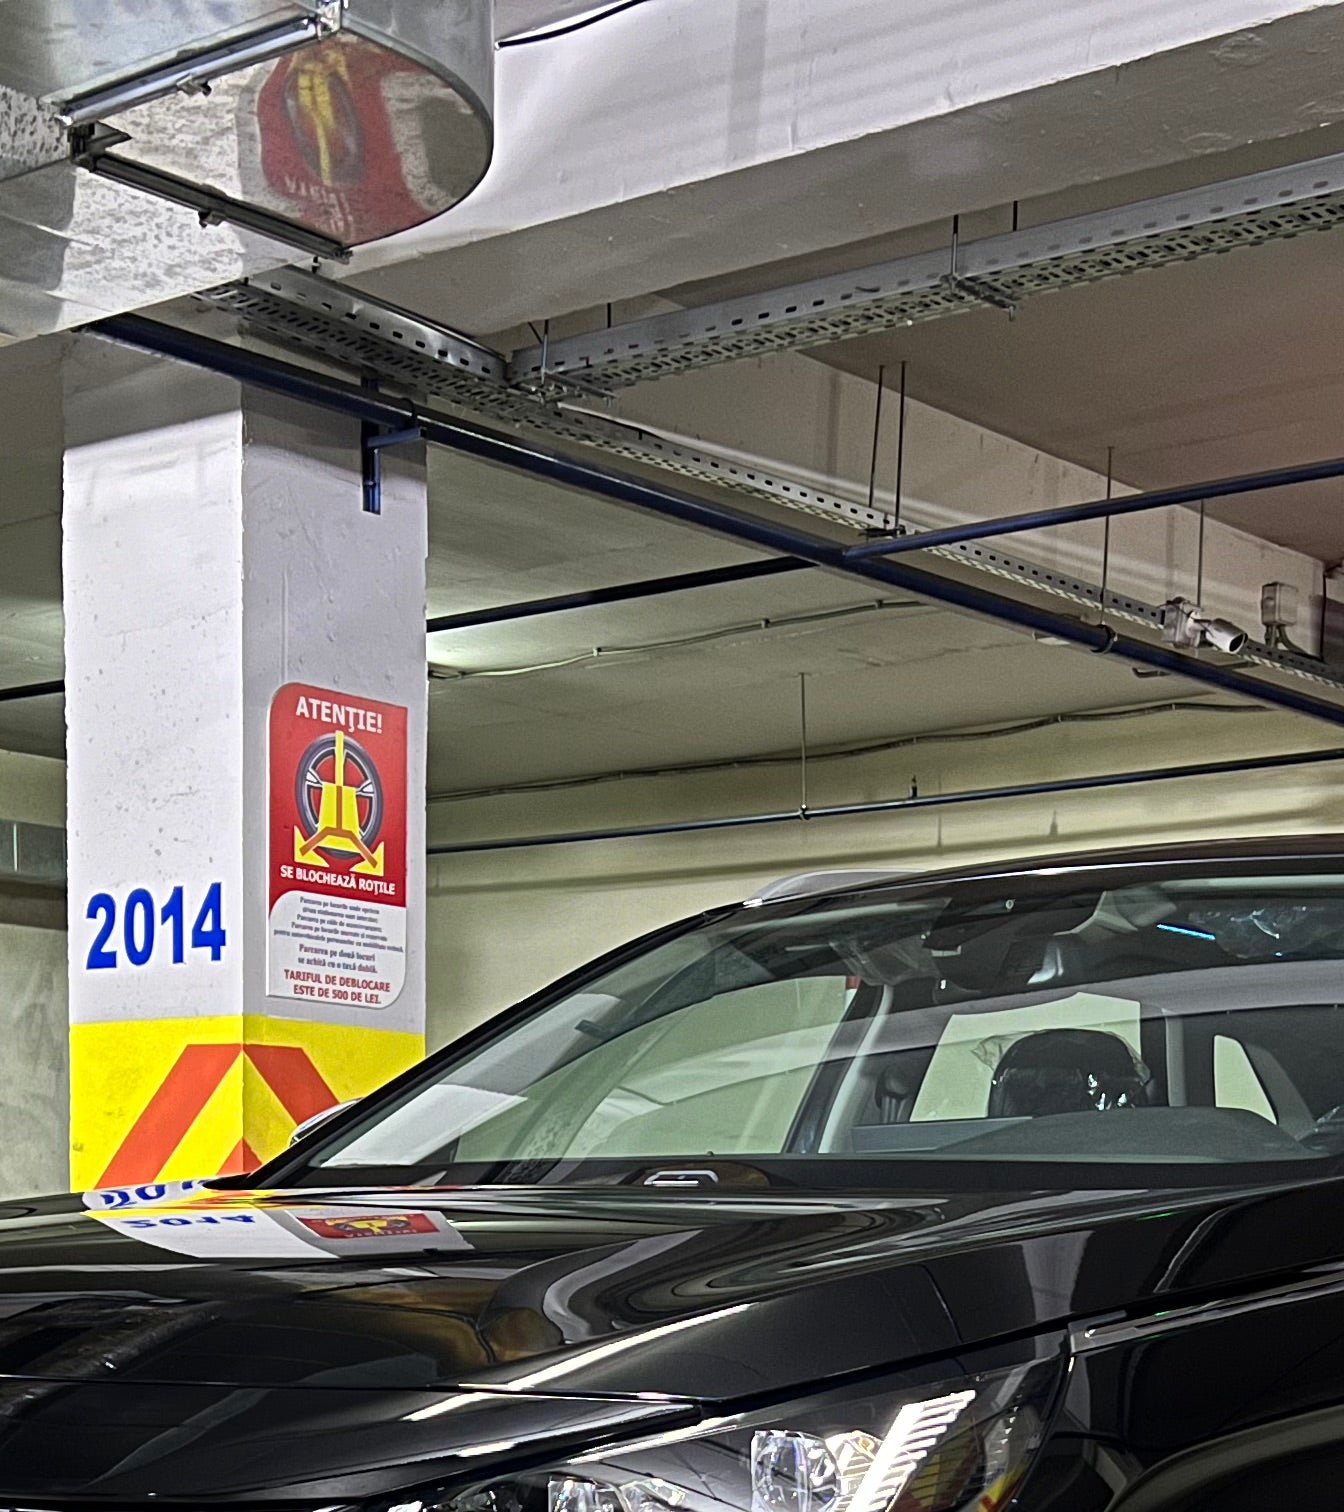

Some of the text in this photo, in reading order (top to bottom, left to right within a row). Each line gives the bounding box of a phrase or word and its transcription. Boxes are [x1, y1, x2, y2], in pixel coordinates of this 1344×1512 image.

[280, 865, 294, 879] SE
[296, 867, 356, 890] BLOCHEAZĂ
[86, 882, 227, 971] 2014
[284, 969, 391, 993] TARIFUL DE DEBLOCARE
[293, 984, 316, 996] ESTE
[318, 988, 330, 998] DE
[332, 990, 348, 1000] 500
[351, 992, 362, 1002] DE
